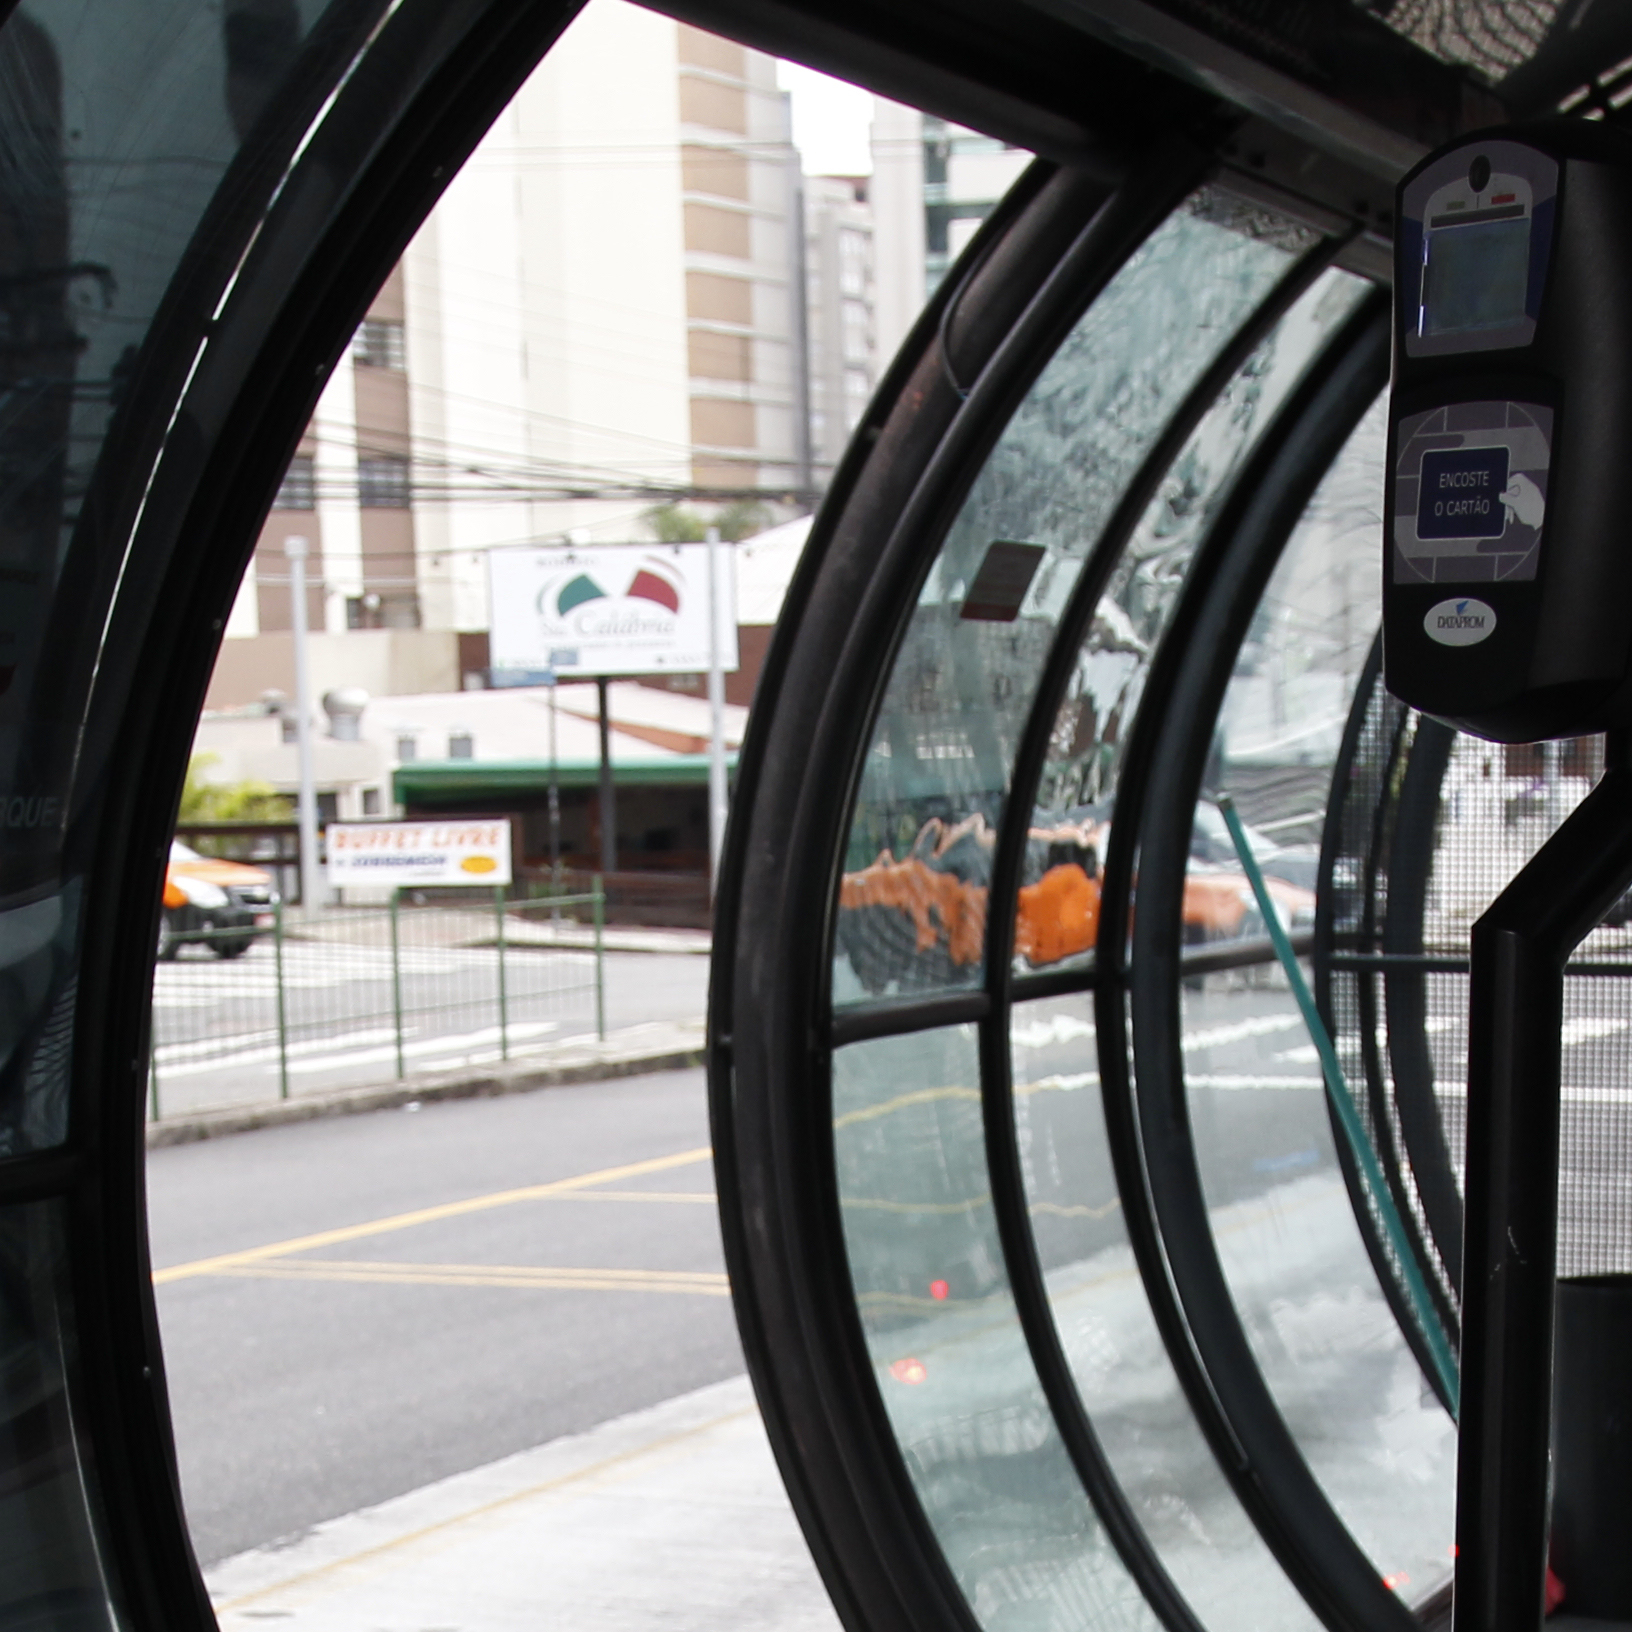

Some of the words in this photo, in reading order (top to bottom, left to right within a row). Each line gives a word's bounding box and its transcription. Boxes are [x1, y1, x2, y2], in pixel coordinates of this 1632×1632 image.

[1439, 470, 1490, 488] ENCOSTE
[1434, 501, 1444, 517] O
[1446, 496, 1490, 516] CARTÃO
[1437, 615, 1485, 629] DATAPROM
